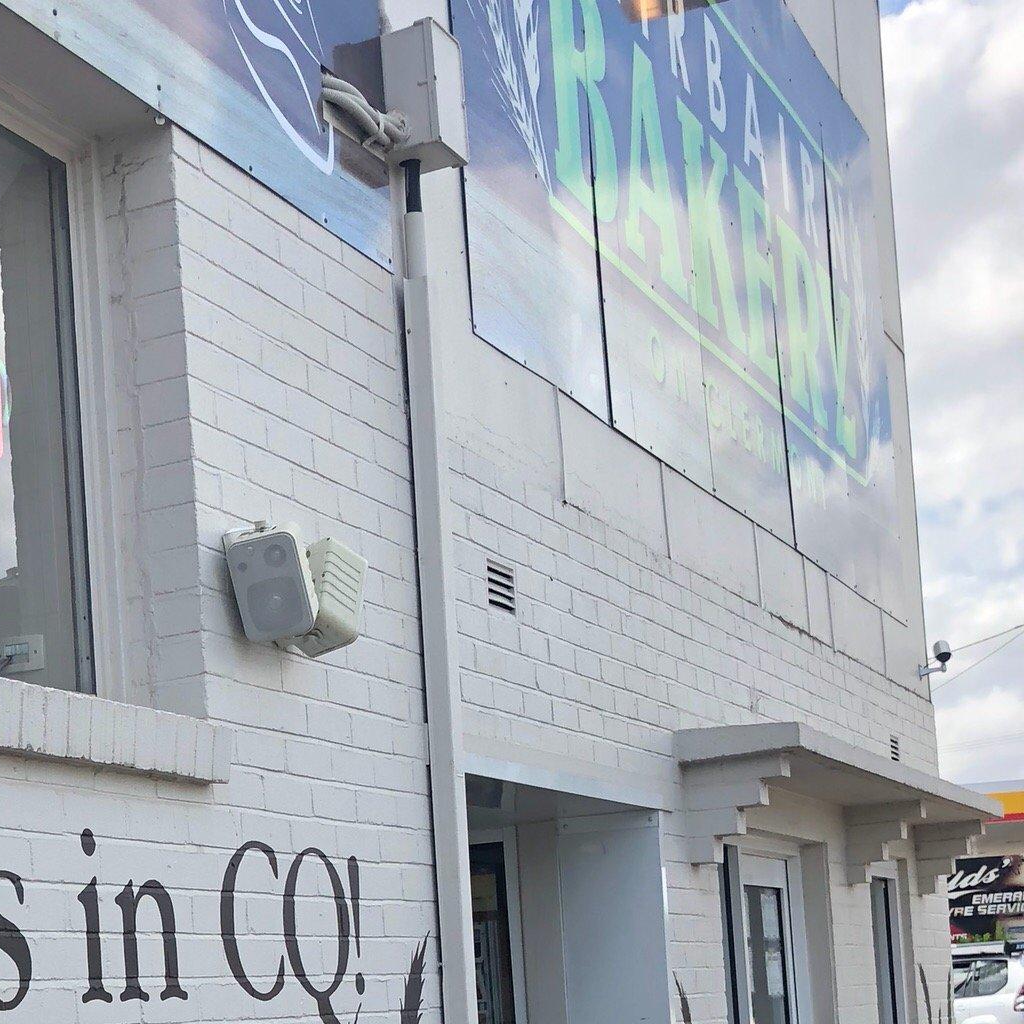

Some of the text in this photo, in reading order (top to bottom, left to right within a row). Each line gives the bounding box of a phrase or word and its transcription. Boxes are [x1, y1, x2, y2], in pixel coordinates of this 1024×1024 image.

[548, 0, 857, 460] BAKERY
[78, 827, 189, 1004] in
[972, 891, 1024, 905] EMERA
